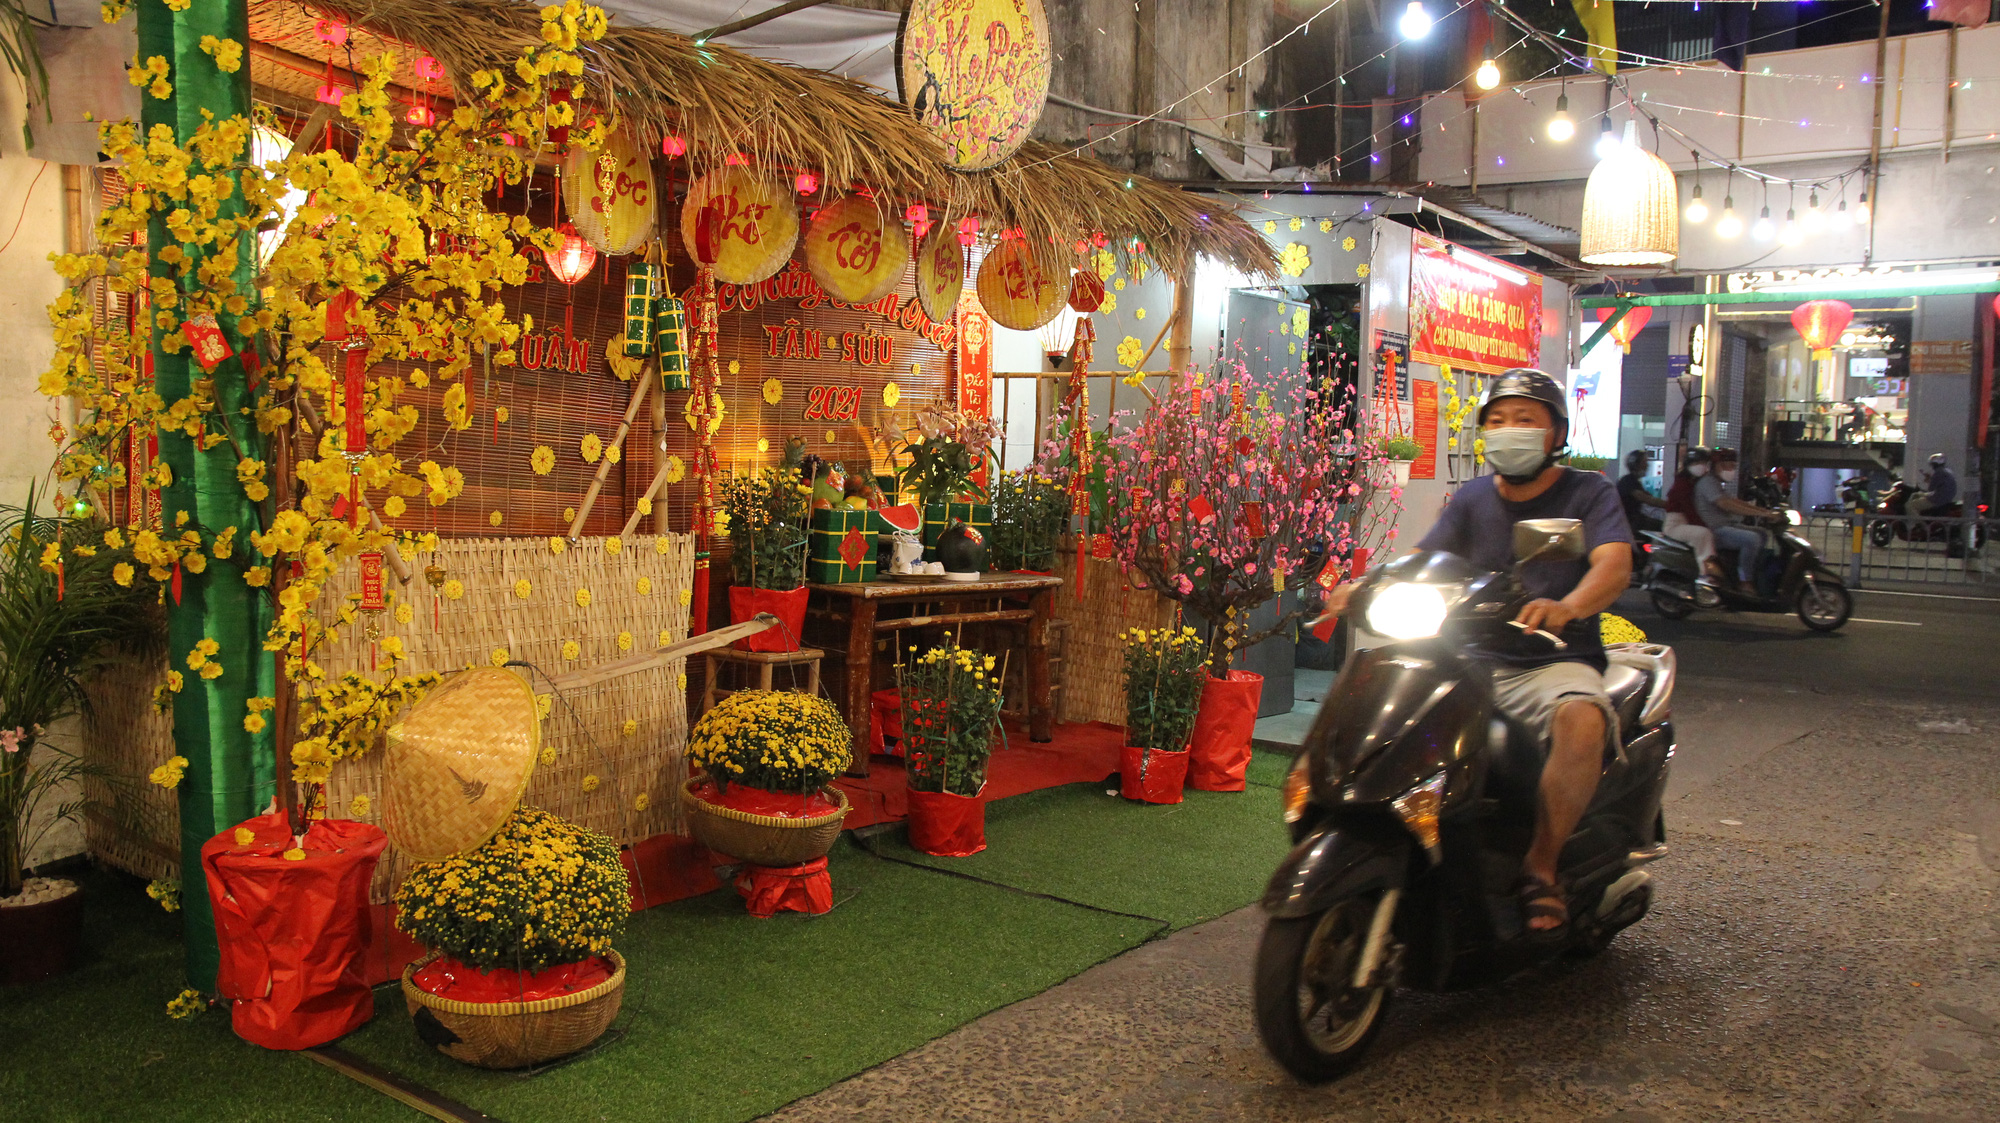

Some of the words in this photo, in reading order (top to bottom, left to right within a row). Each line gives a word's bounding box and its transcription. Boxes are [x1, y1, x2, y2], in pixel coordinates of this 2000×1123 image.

[591, 157, 648, 214] Góc
[827, 221, 882, 275] Tôi
[1482, 291, 1506, 328] TẶNG
[1508, 301, 1525, 332] QUÀ
[762, 318, 822, 360] TÂN
[840, 323, 895, 366] SỬU
[1434, 321, 1447, 346] CÁC
[963, 371, 985, 387] Đắc
[966, 388, 982, 405] Tài
[804, 385, 863, 421] 2021
